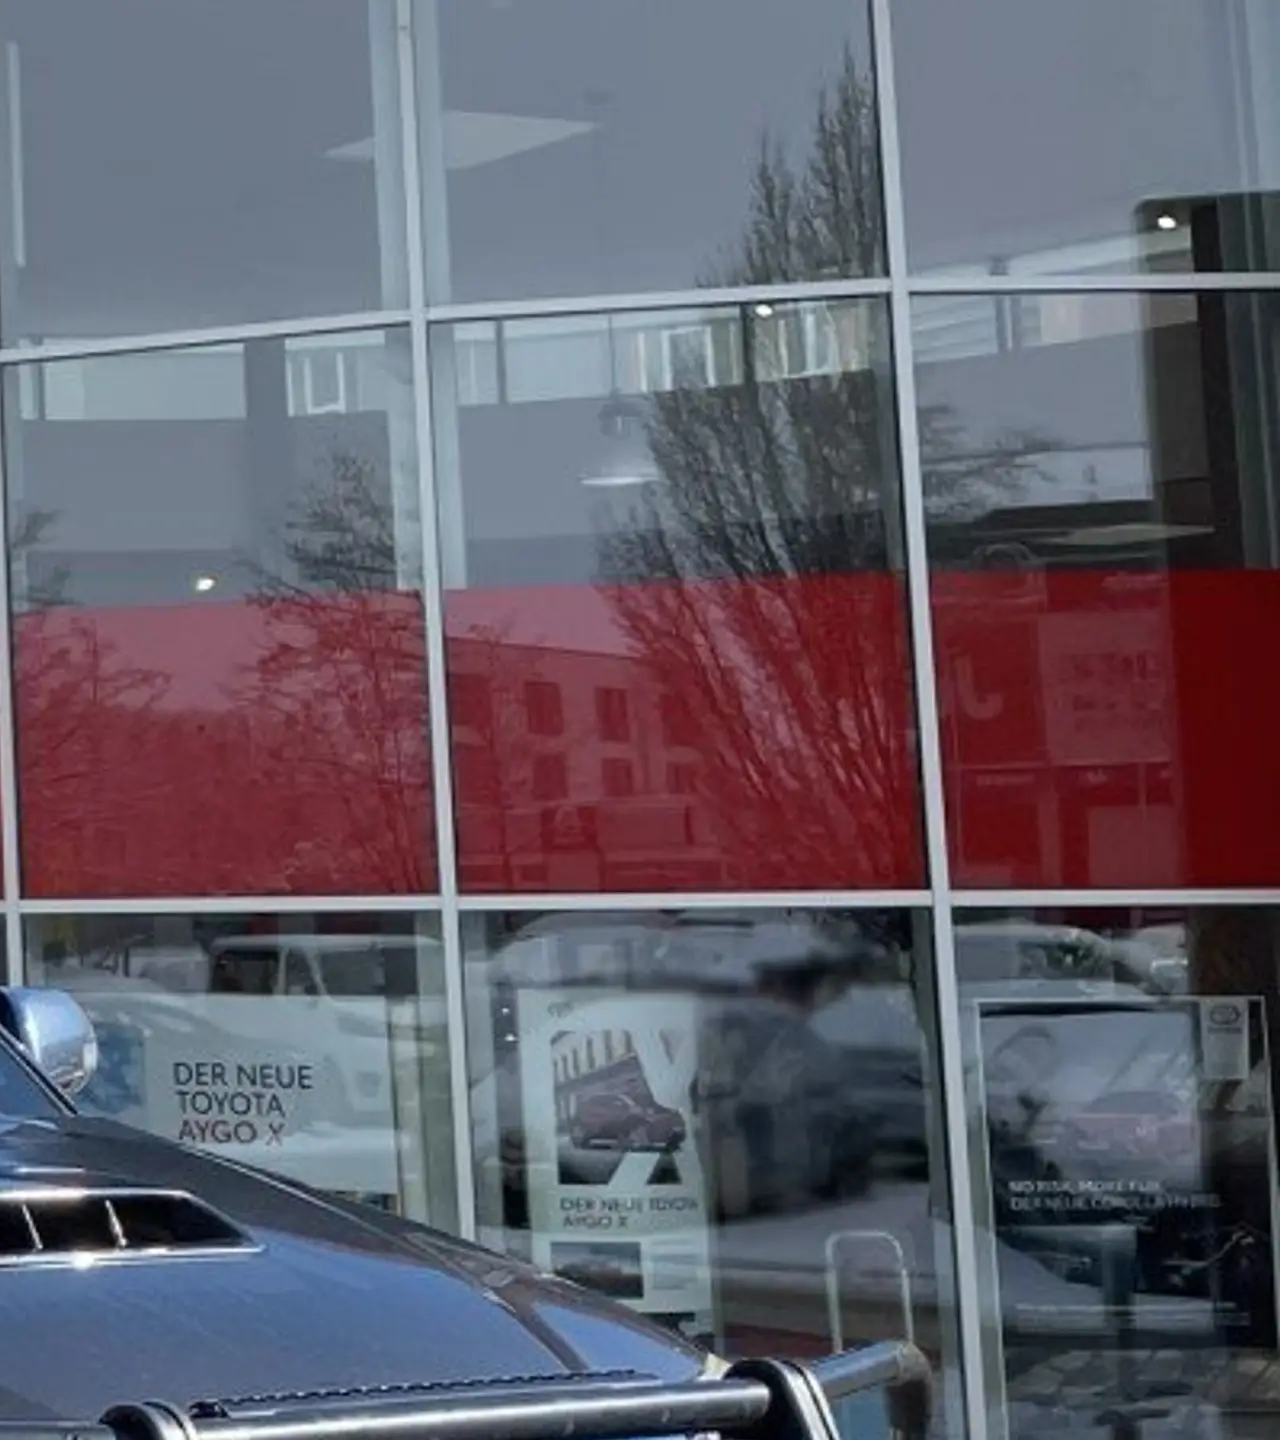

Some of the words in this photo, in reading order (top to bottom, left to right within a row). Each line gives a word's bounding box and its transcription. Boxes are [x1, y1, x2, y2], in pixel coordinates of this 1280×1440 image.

[172, 1061, 229, 1087] DER
[237, 1064, 314, 1090] NEUE
[175, 1089, 286, 1118] TOYOTA
[178, 1119, 258, 1144] AYGO
[265, 1122, 286, 1146] X
